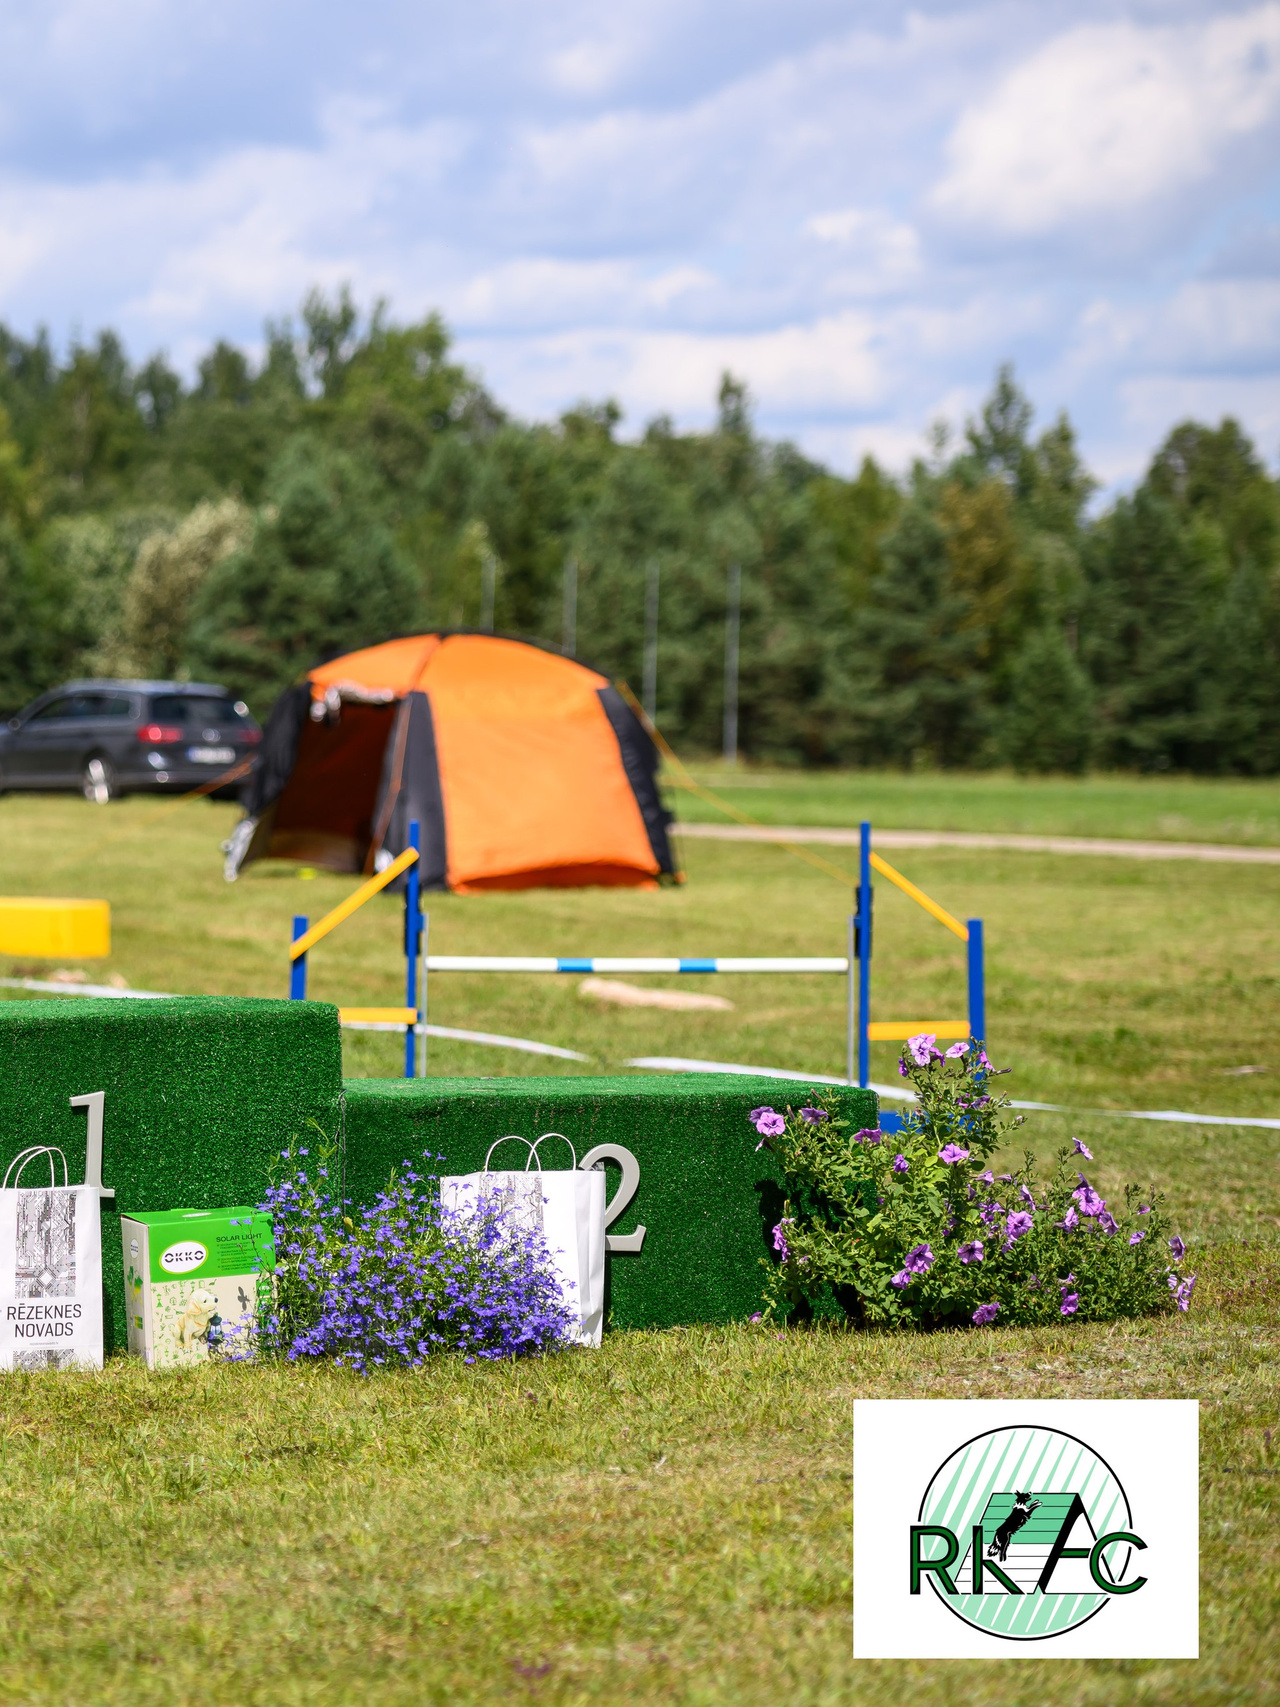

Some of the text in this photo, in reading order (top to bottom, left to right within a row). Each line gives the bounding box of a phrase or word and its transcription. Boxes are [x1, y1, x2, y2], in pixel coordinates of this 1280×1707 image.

[69, 1091, 116, 1198] 1
[579, 1143, 647, 1252] 2
[216, 1235, 240, 1243] SOLAR
[164, 1250, 204, 1264] OKKO
[6, 1303, 82, 1321] RĒZEKNES
[14, 1322, 74, 1338] NOVADS
